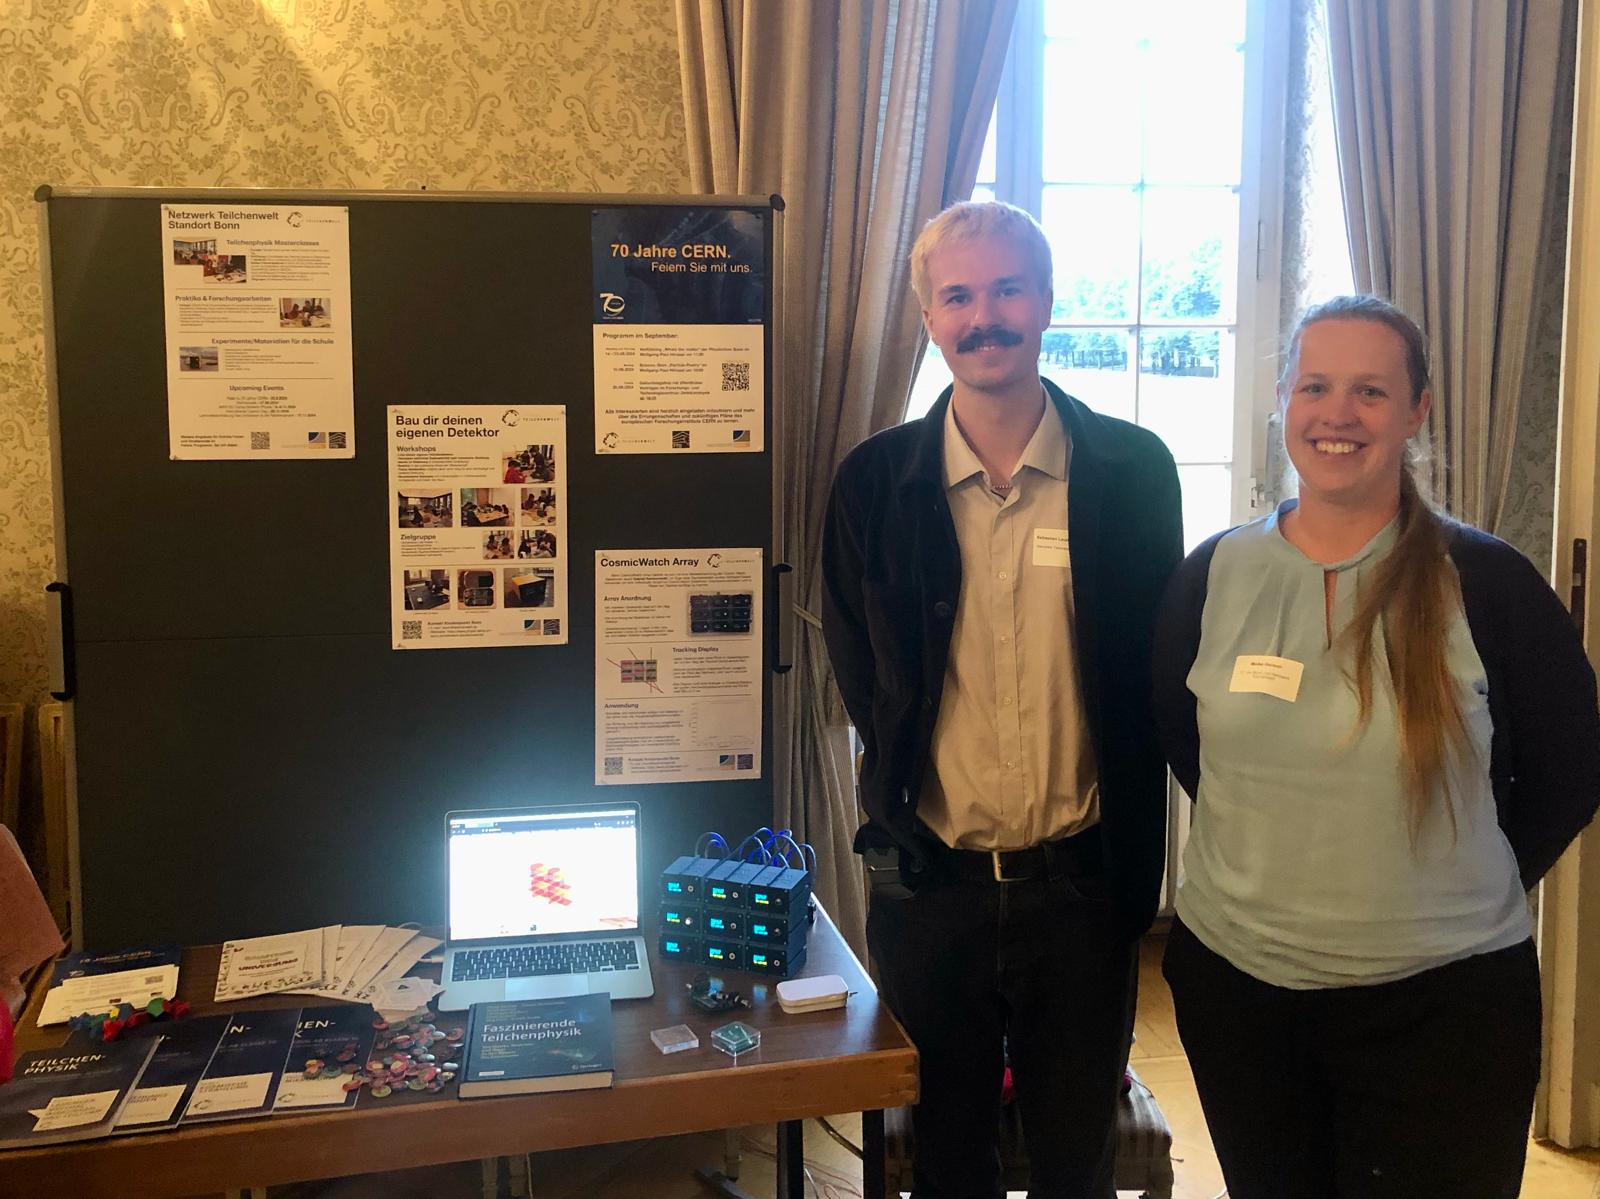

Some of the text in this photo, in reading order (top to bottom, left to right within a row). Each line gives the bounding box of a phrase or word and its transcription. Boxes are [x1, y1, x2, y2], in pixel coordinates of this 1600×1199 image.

[168, 210, 279, 220] Netzwerk Teilchenwelt
[168, 220, 240, 230] Standort Bonn
[611, 244, 732, 258] 70 Jahre CERN.
[690, 262, 707, 272] Sie
[710, 262, 727, 272] mit
[730, 264, 752, 272] uns.
[396, 415, 482, 426] Bau dir deinen
[396, 427, 500, 439] eigenen Detektor
[600, 557, 699, 567] CosmicWatch Array
[484, 1018, 576, 1033] Faszinierende
[480, 1028, 582, 1042] Teilchenphysik
[30, 1054, 106, 1067] TEILCHEN-
[24, 1064, 80, 1075] PHYSIK
